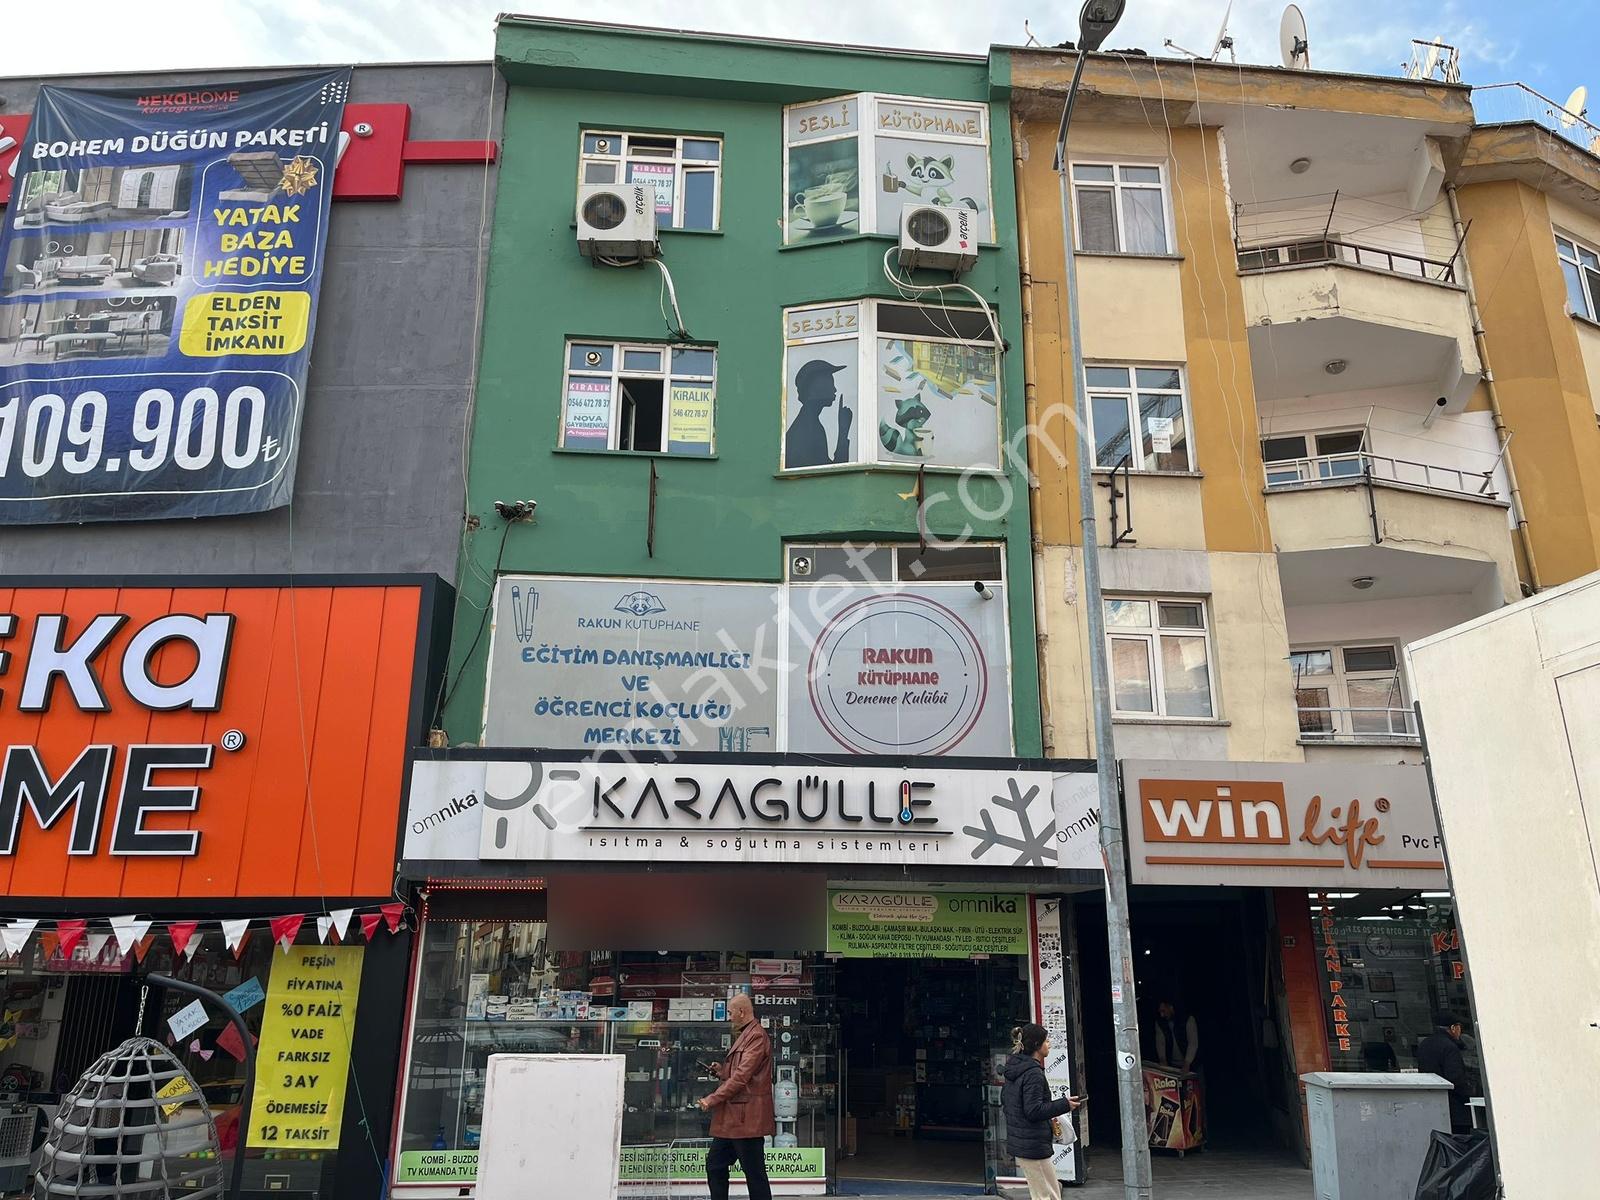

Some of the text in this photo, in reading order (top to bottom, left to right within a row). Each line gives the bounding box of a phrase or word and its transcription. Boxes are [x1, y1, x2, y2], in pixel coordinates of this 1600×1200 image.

[799, 105, 850, 133] SESLİ
[880, 110, 979, 135] KÜTÜPHANE
[33, 121, 329, 159] BOHEM DÜĞÜN PAKETİ
[634, 186, 646, 215] arçelik
[213, 204, 301, 226] YATAK
[960, 211, 968, 240] arçelik
[220, 230, 293, 253] BAZA
[203, 252, 306, 279] HEDİYE
[211, 296, 281, 312] ELDEN
[207, 311, 283, 331] TAKSİT
[791, 310, 857, 334] SESSİZ
[205, 331, 285, 352] İMKANI
[569, 383, 610, 392] KIRALIK
[584, 399, 594, 407] 472
[595, 399, 602, 407] 78
[578, 618, 621, 629] RAKUN
[522, 644, 751, 671] EĞİTİM DANIŞMANLIĞI
[862, 648, 933, 665] RAKUN
[621, 676, 649, 691] VE
[858, 670, 939, 686] KÜTÜPHANE
[846, 690, 949, 705] Deneme Kulübü
[534, 696, 732, 723] ÖĞRENCİ KOÇLUĞU
[584, 725, 681, 746] MERKEZİ
[592, 775, 938, 824] KARAGÜLLE
[412, 791, 479, 835] omnika
[1056, 808, 1100, 843] omnik
[1148, 785, 1284, 838] win
[1299, 795, 1386, 870] life
[589, 836, 940, 852] ısıtma & soğutma sistemleri
[1402, 835, 1429, 848] Pvc
[839, 894, 933, 907] KARAGÜLLE
[949, 895, 1016, 913] omnika
[832, 923, 848, 931] KOMBİ
[302, 955, 336, 969] PEŞİN
[287, 977, 344, 991] FİYATINA
[1041, 973, 1061, 992] omnika
[281, 1001, 343, 1017] %0 FAİZ
[291, 1028, 325, 1040] VADE
[278, 1050, 330, 1063] FARKSIZ
[1046, 1054, 1067, 1074] omnika
[283, 1075, 320, 1089] 3 AY
[265, 1100, 328, 1115] ÖDEMESİZ
[261, 1126, 330, 1141] 12 TAKSİT
[421, 1153, 446, 1164] KOMBİ
[452, 1155, 479, 1164] BUZDO
[778, 1153, 802, 1163] PARÇA
[1052, 1146, 1072, 1166] omnika
[408, 1168, 417, 1176] TV
[419, 1167, 456, 1176] KUMANDA
[459, 1167, 468, 1175] TV
[470, 1167, 478, 1175] LE
[680, 1163, 706, 1173] SOĞUT
[776, 1164, 816, 1174] PARÇALARI
